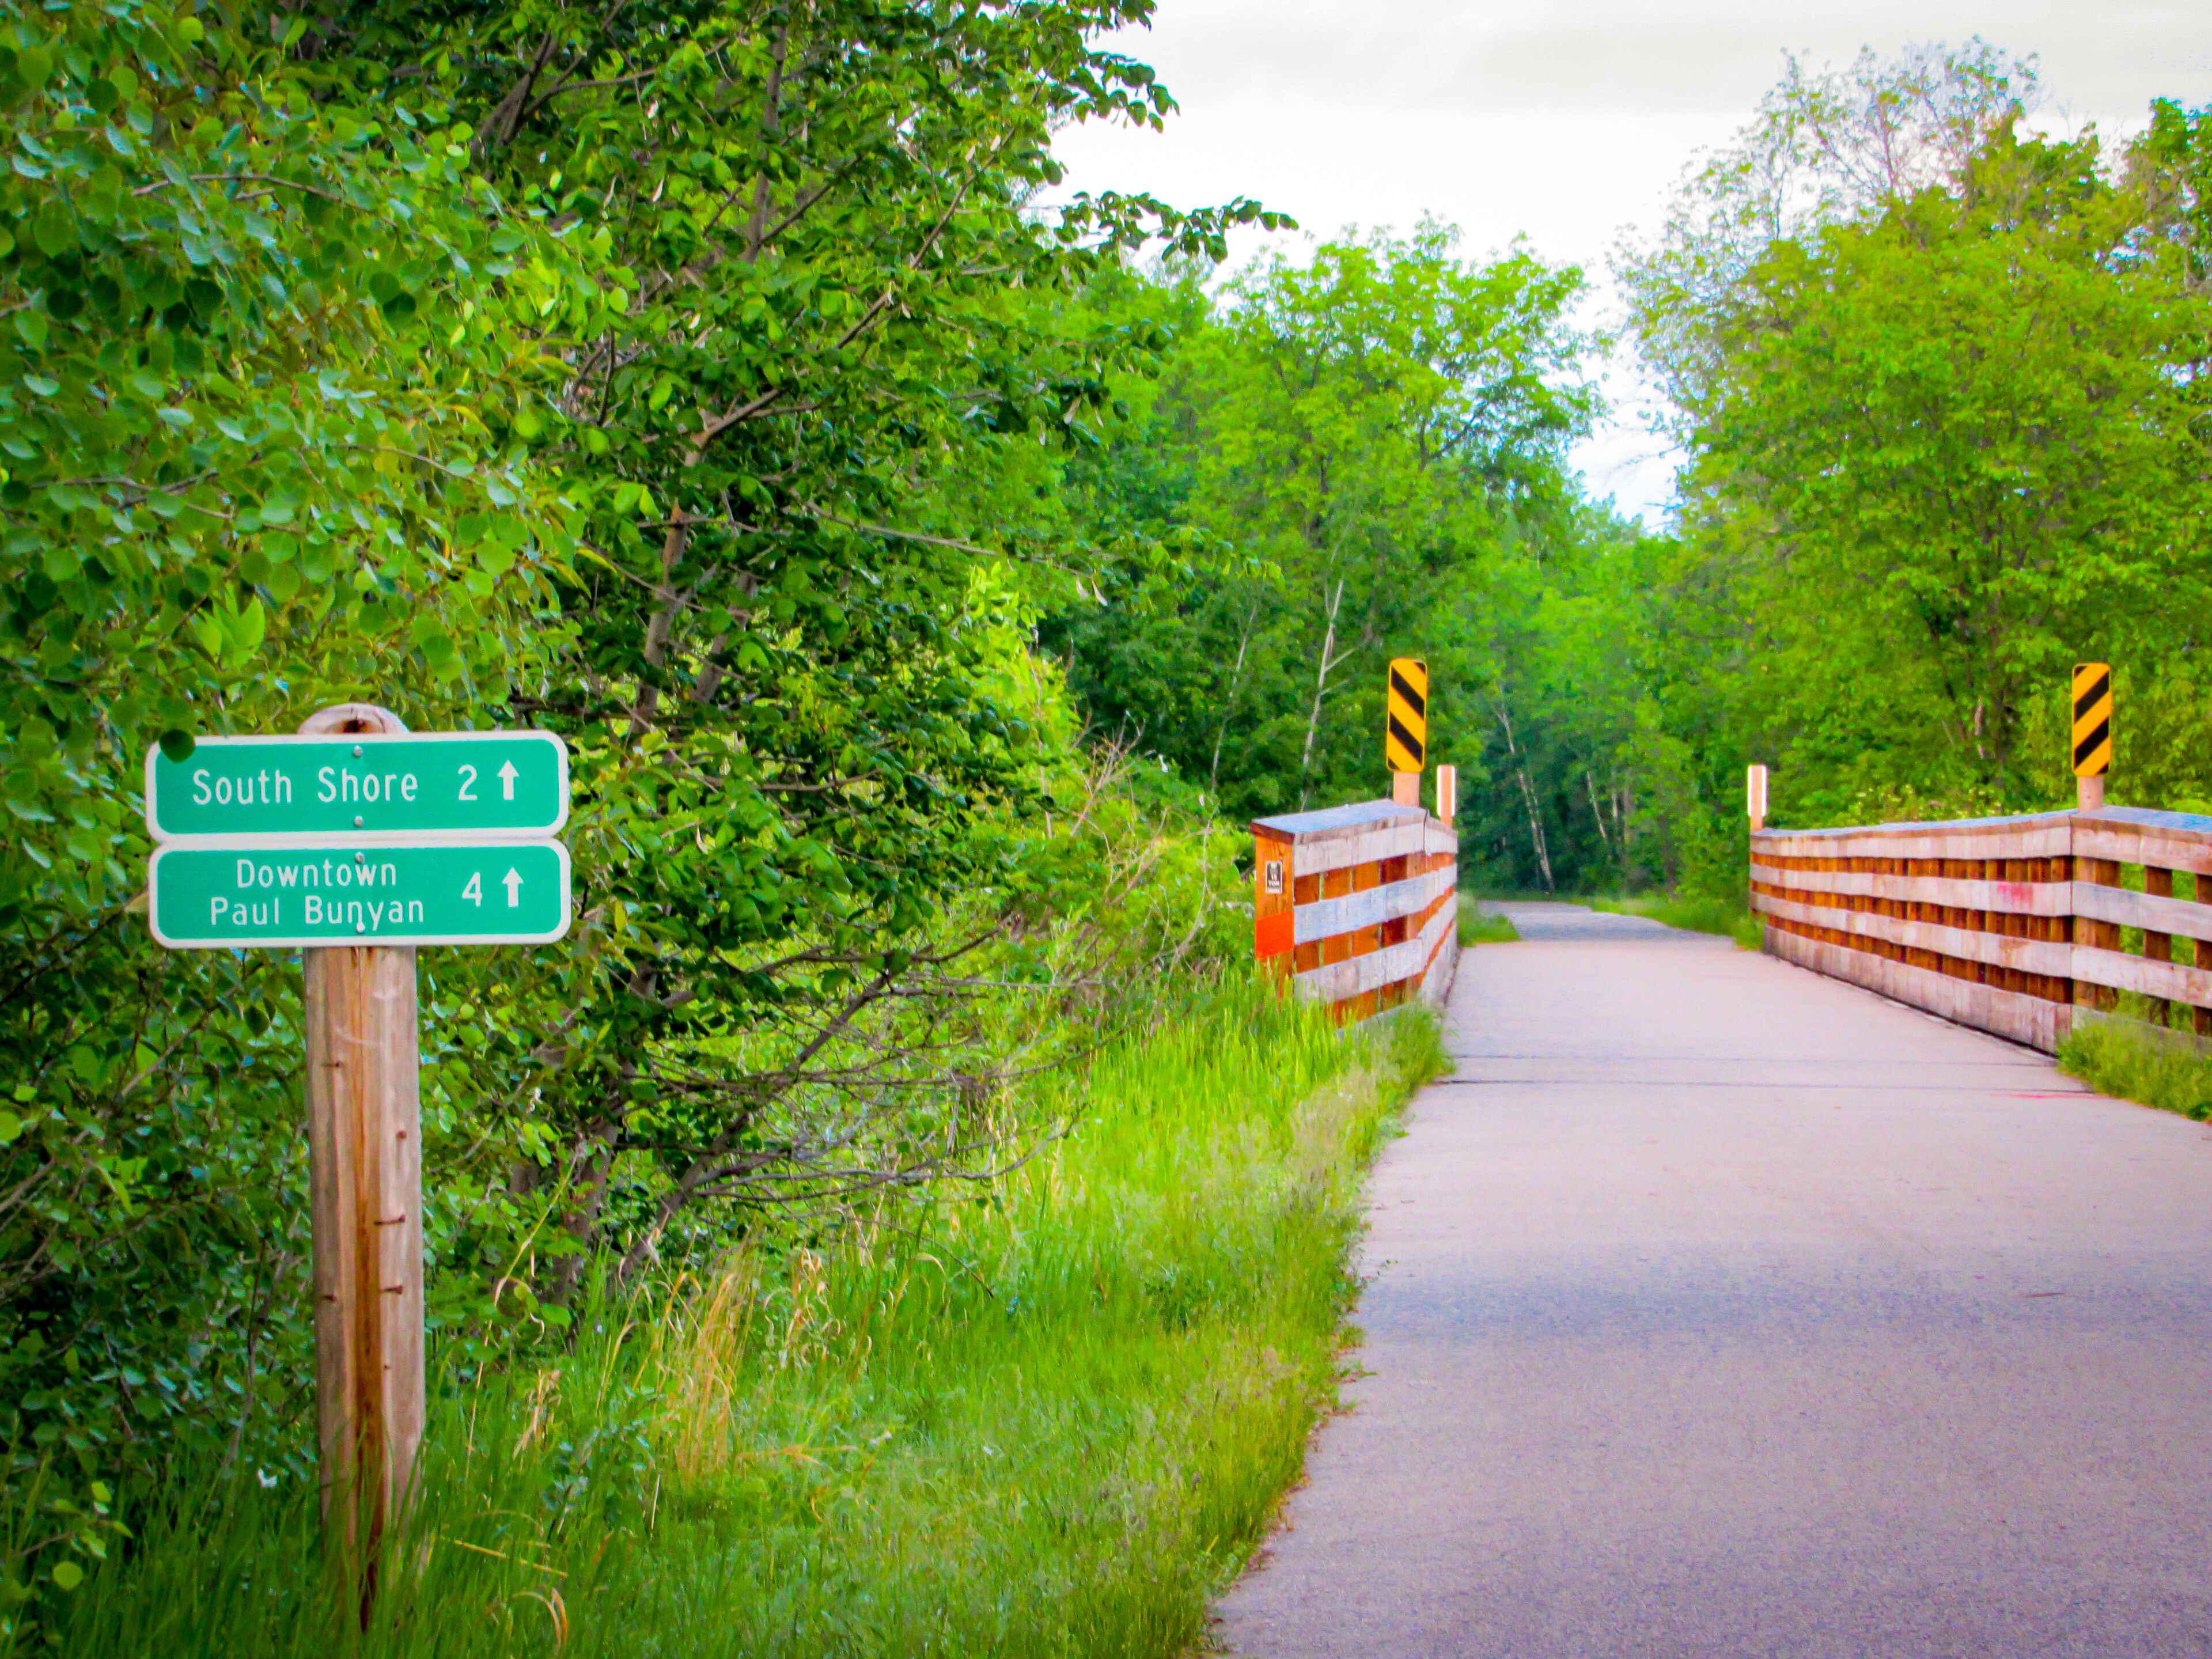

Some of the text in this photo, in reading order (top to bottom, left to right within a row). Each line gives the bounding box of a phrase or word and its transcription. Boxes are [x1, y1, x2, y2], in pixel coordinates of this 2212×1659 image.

[192, 764, 478, 805] South Shore 2
[237, 858, 396, 888] Downtown
[461, 872, 483, 907] 4
[211, 895, 424, 931] Paul Bunyan
